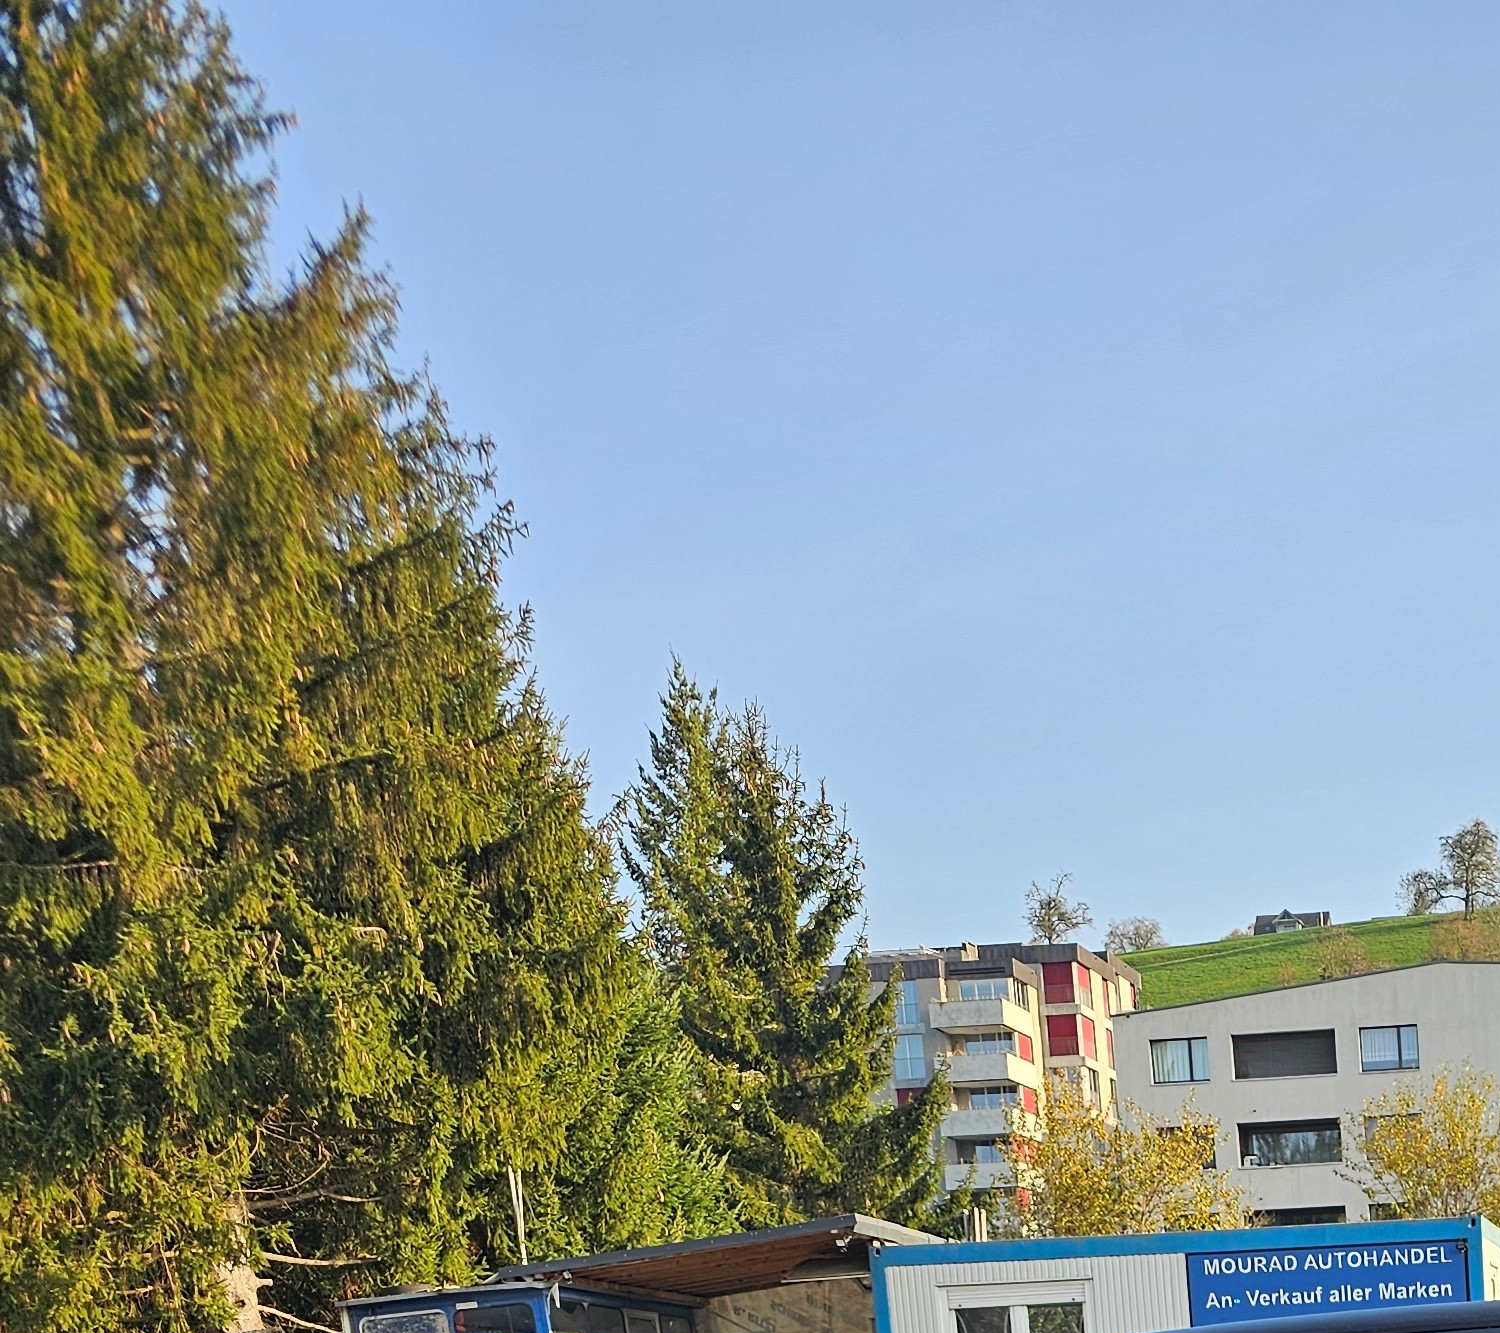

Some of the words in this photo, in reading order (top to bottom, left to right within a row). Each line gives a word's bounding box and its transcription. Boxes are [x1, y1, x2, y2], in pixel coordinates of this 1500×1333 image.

[1203, 1255, 1298, 1276] MOURAD
[1303, 1247, 1453, 1271] AUTOHANDEL
[1205, 1292, 1241, 1309] An-
[1245, 1285, 1323, 1307] Verkauf
[1329, 1284, 1373, 1302] aller
[1378, 1281, 1453, 1300] Marken
